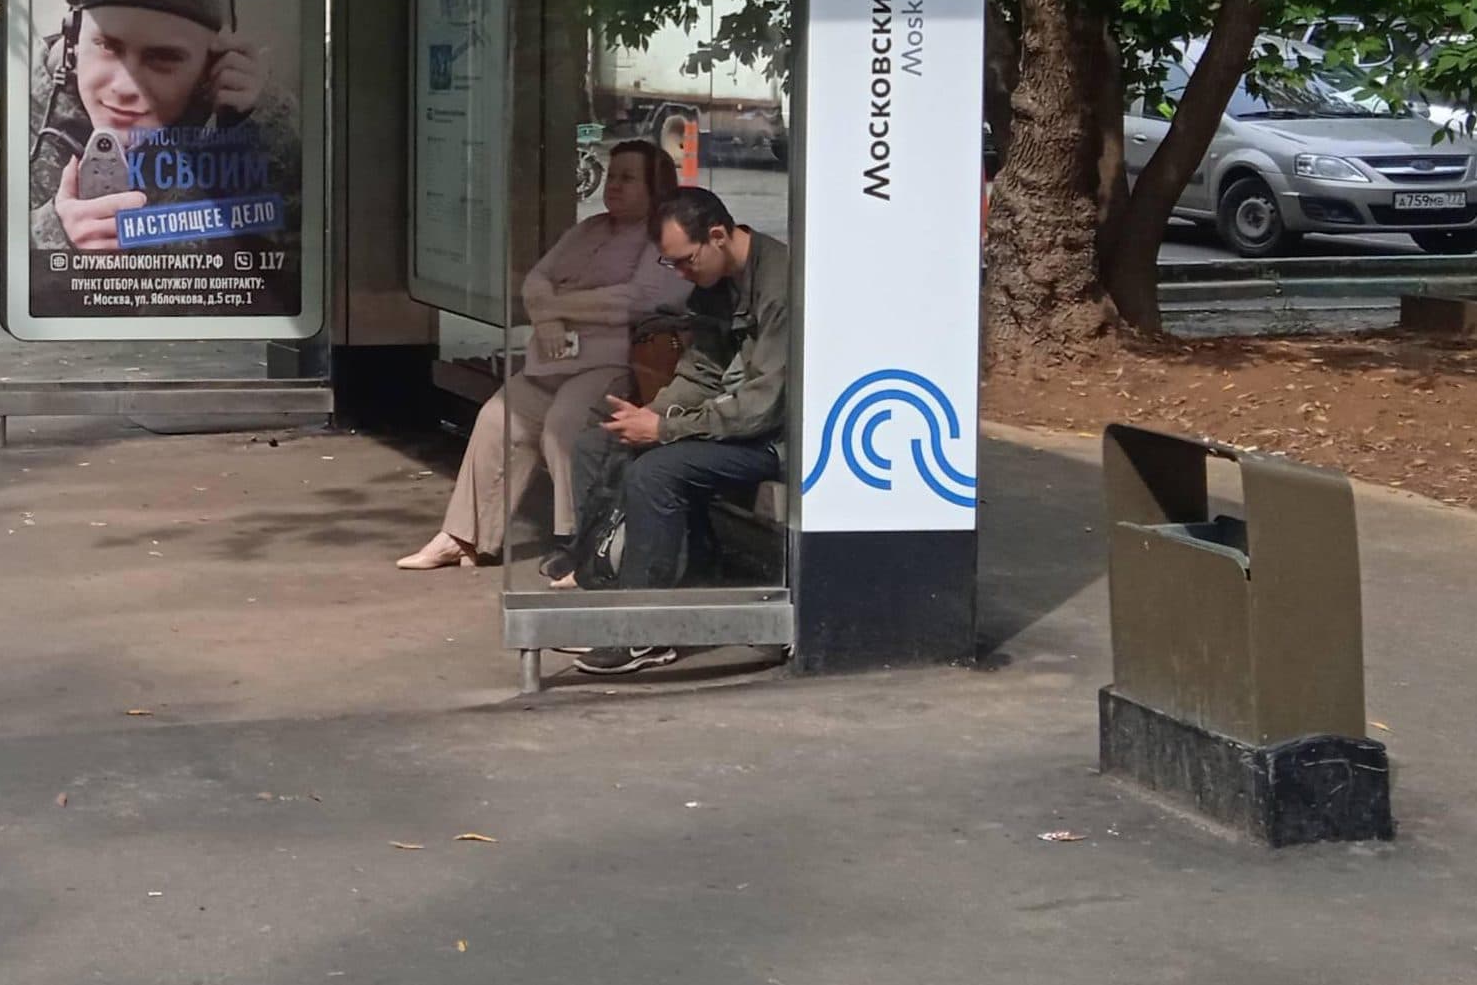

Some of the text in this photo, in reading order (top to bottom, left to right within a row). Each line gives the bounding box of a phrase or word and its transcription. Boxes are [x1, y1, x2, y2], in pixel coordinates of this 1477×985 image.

[127, 149, 269, 191] К СВОИМ
[123, 201, 276, 238] НАСТОЯЩЕЕ ДЕЛО
[72, 252, 285, 270] СЛУЖБАПОКОНТРАКТУ.РФ 117
[71, 276, 265, 291] ПУНКТ ОТБОРА НА СЛУЖБУ ПО КОНТРАКТУ:
[83, 292, 253, 306] г. Москва, ул. Яблочкова, д.5 стр. 1
